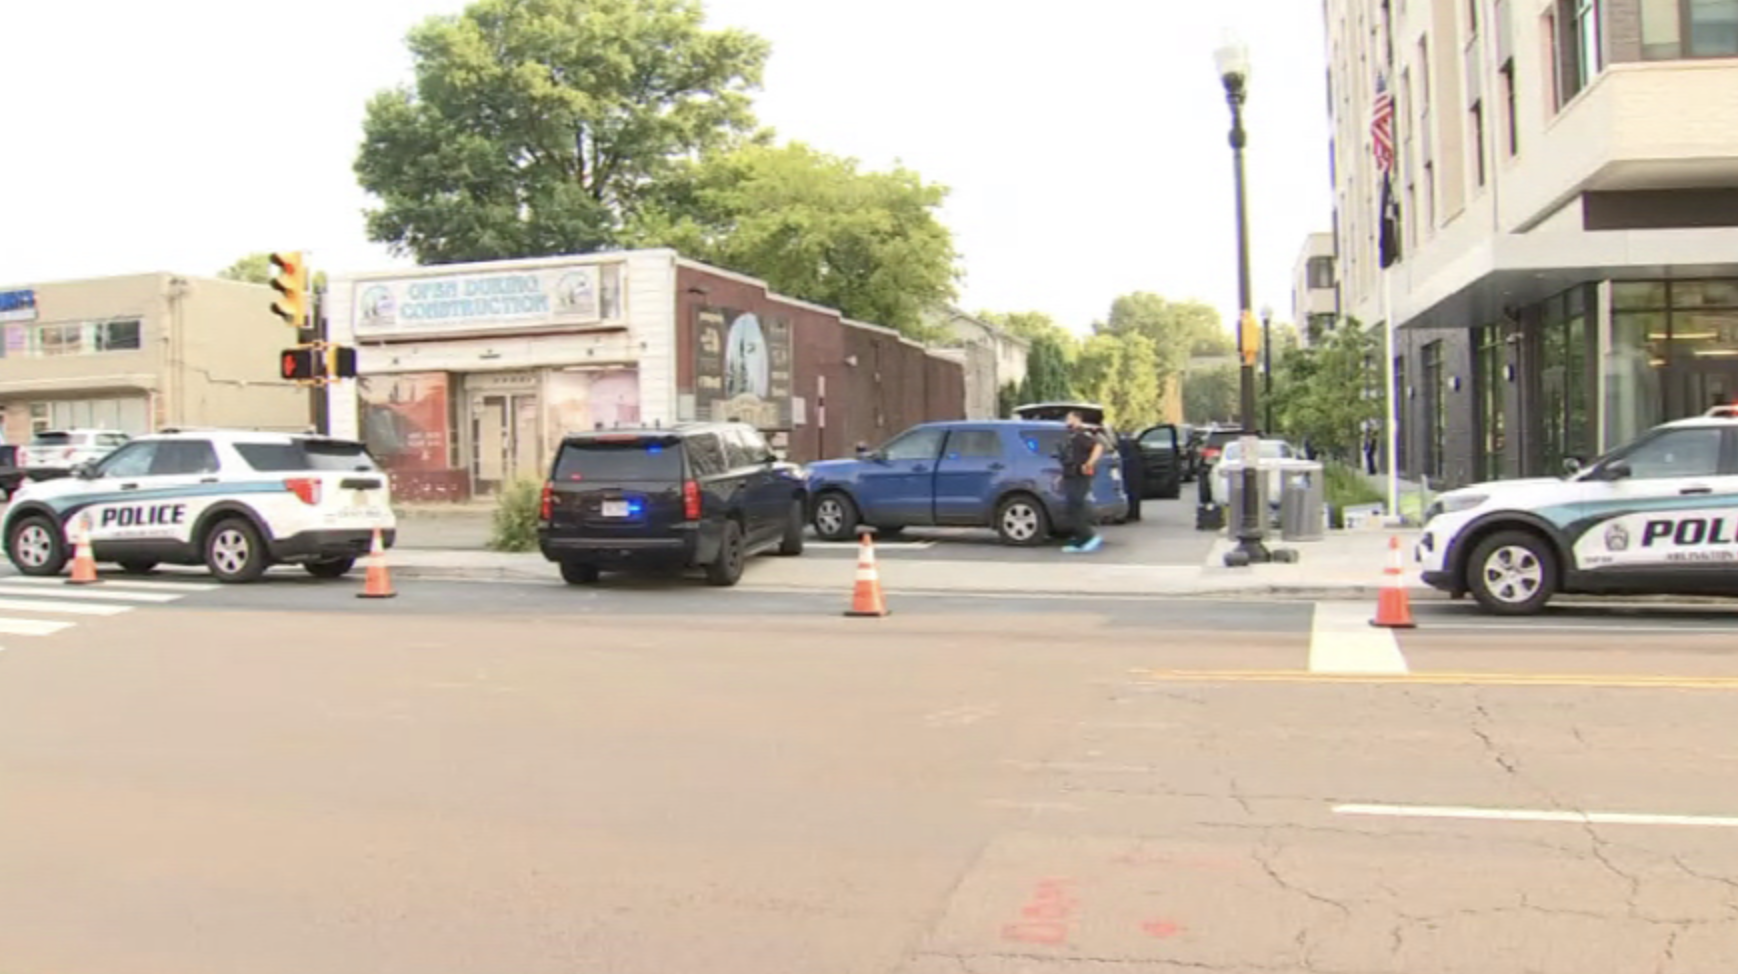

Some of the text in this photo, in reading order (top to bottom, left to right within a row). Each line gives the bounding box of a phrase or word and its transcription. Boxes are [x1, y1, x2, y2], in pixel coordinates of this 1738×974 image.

[408, 274, 540, 300] OPEN DURING
[400, 295, 549, 319] CONSTRUCTION
[101, 504, 187, 528] POLICE
